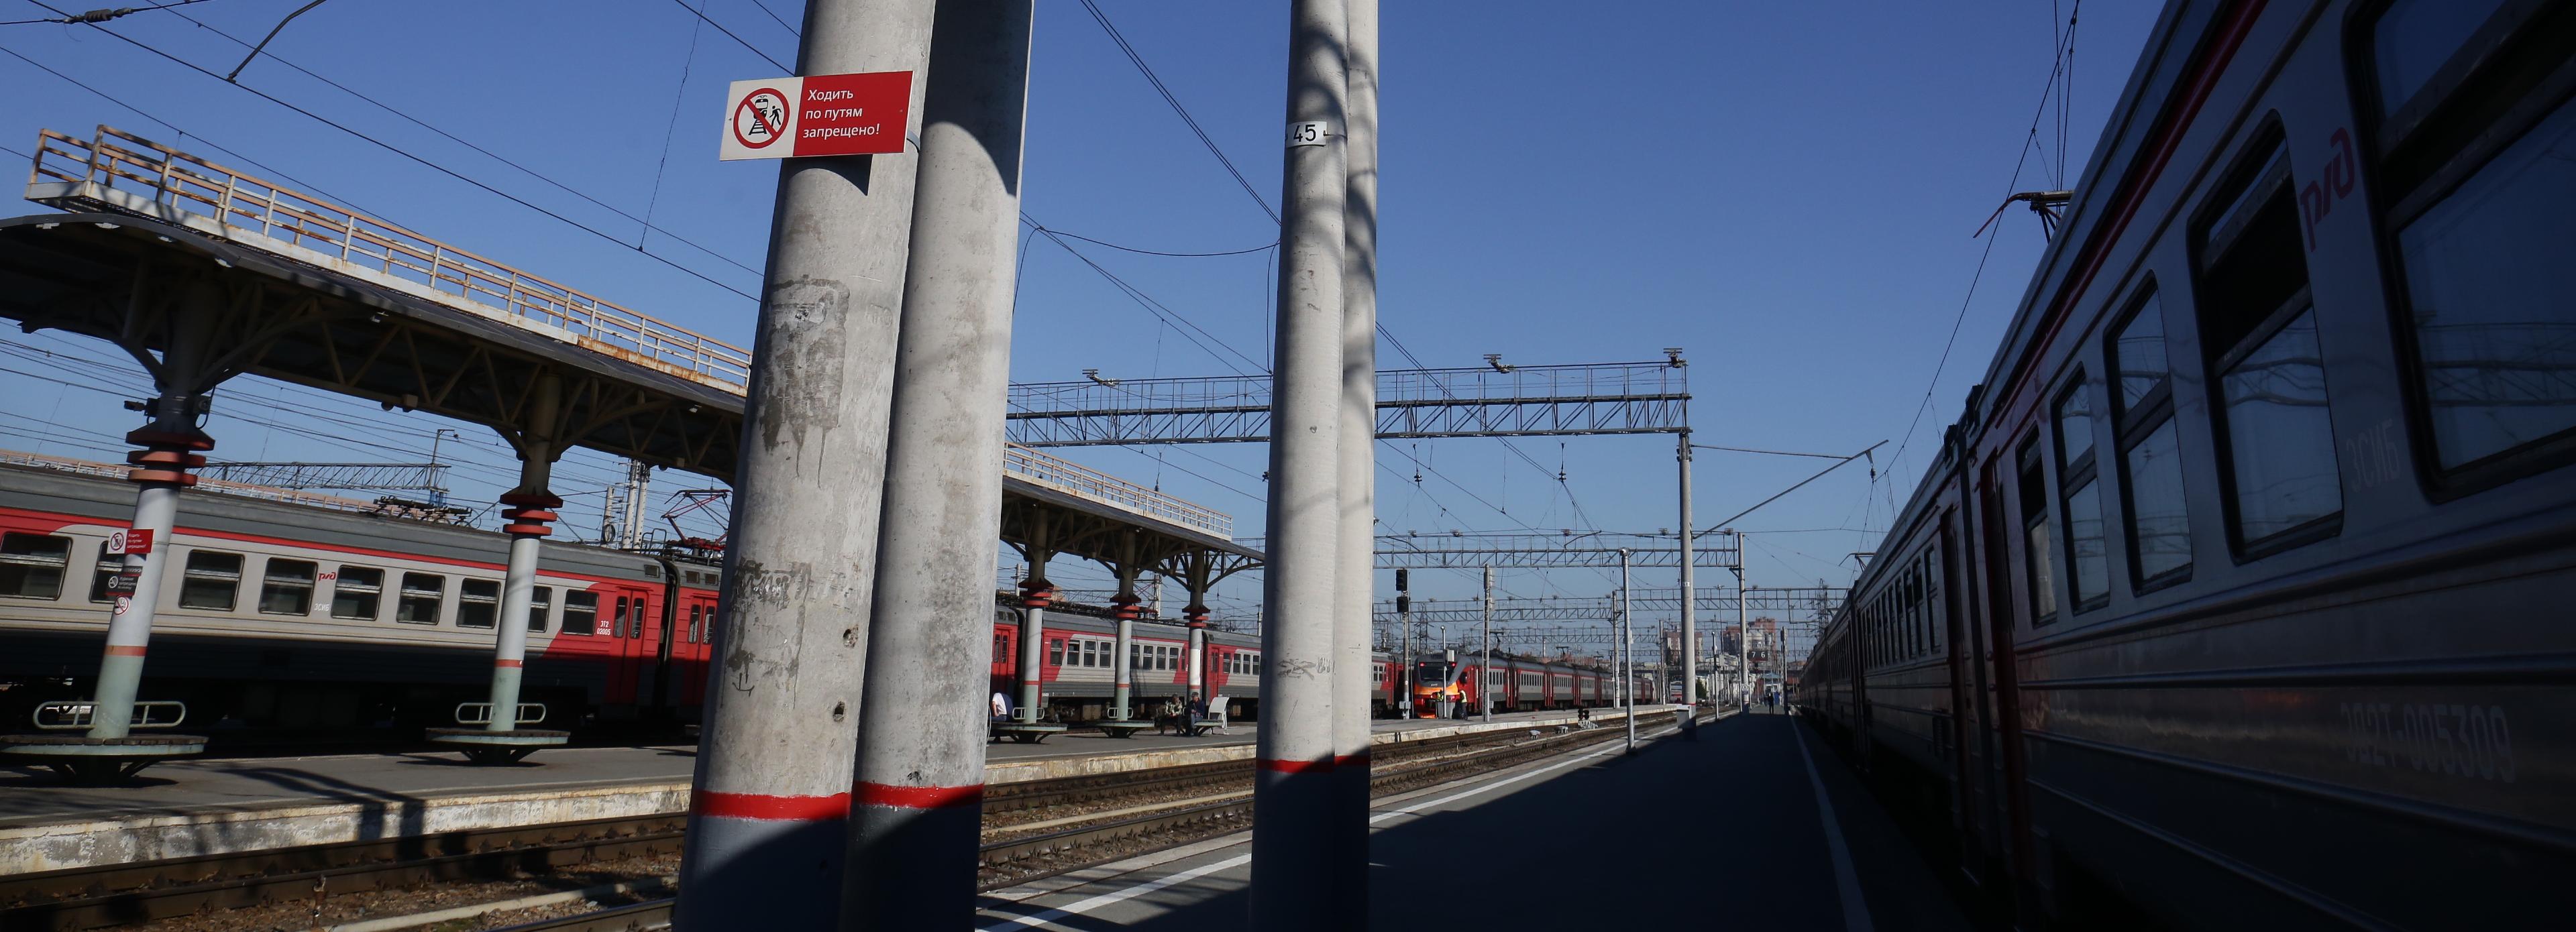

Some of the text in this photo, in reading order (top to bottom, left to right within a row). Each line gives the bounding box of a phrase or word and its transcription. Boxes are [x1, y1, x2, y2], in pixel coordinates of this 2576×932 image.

[808, 89, 853, 102] Ходить
[806, 107, 863, 121] по путям
[803, 123, 880, 140] запрещено!
[1293, 124, 1316, 142] 45
